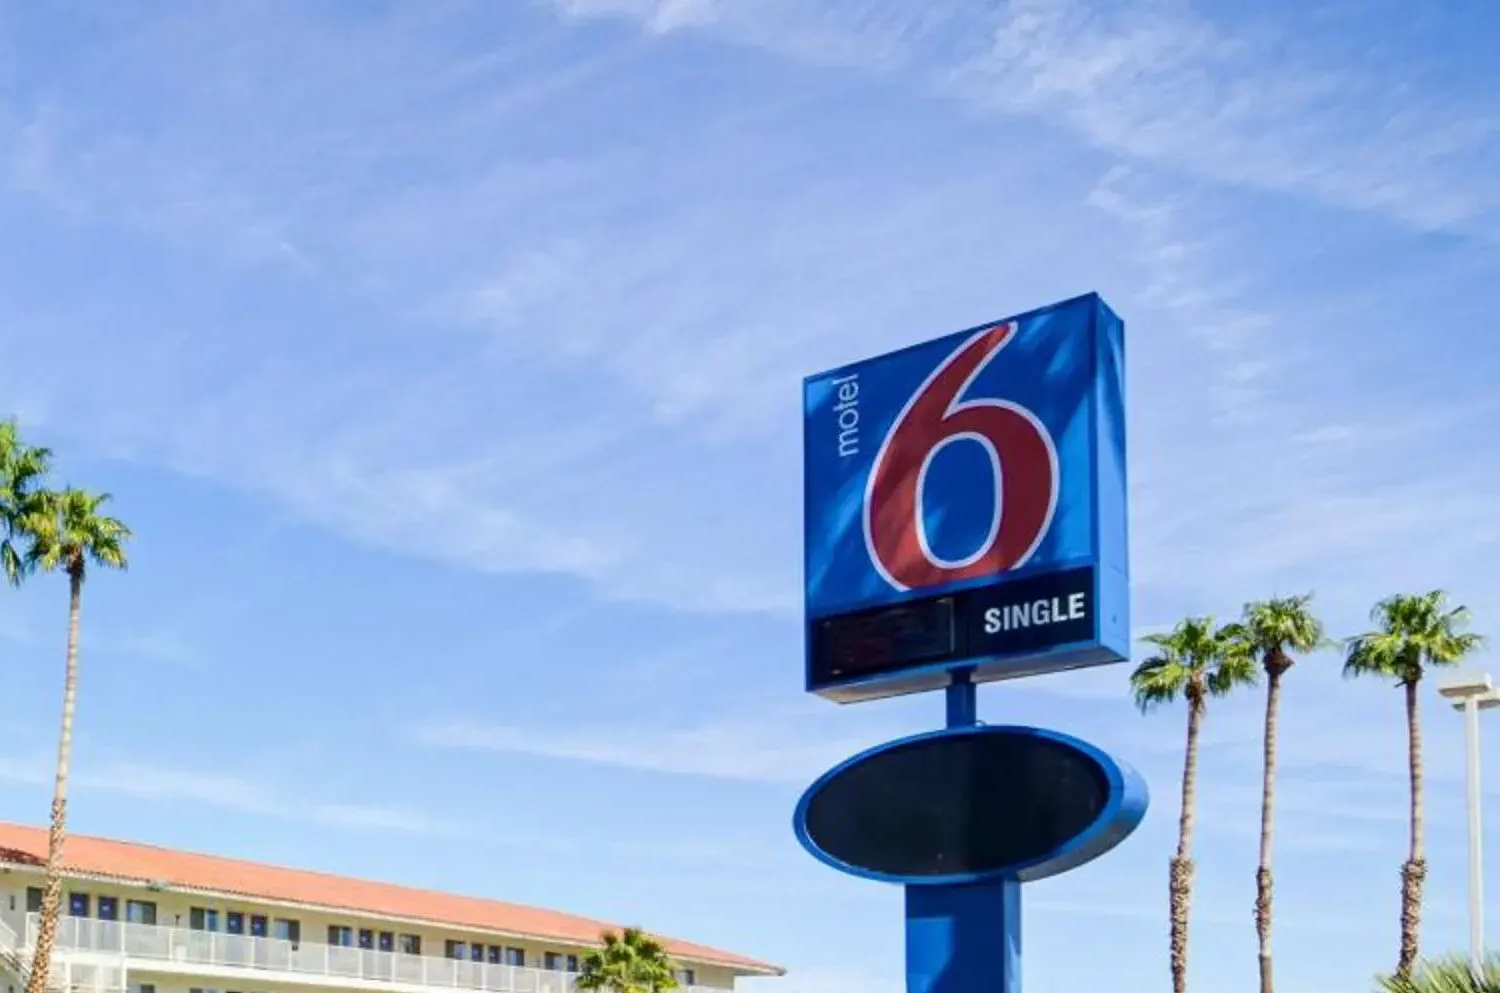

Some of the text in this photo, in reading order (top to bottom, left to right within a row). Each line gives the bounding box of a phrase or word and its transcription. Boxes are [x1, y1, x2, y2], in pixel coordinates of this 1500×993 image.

[832, 373, 860, 458] motel
[863, 321, 1060, 592] 6
[983, 592, 1086, 634] SINGLE
